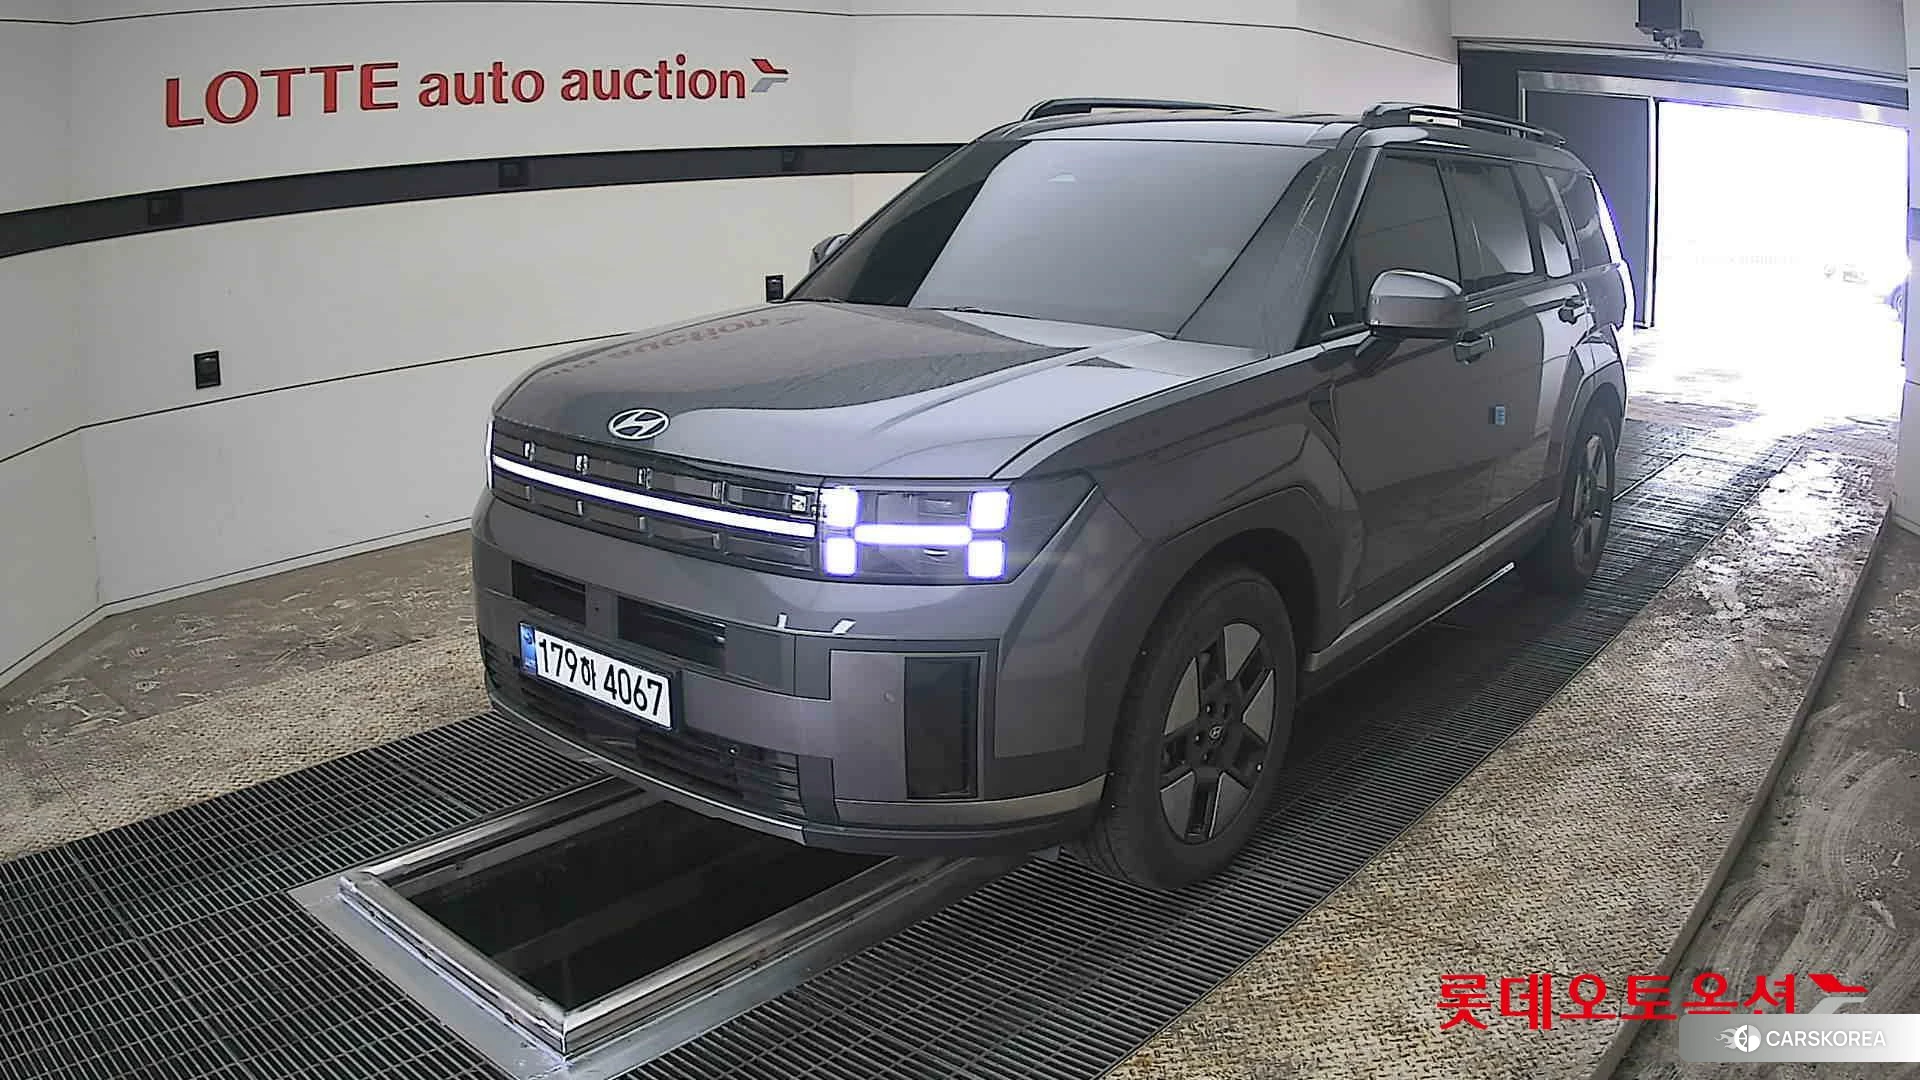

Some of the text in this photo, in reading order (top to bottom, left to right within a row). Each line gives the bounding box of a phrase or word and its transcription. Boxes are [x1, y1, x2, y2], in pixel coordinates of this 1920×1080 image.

[165, 53, 746, 128] LOTTE auto auction
[538, 638, 663, 716] 179하 4067
